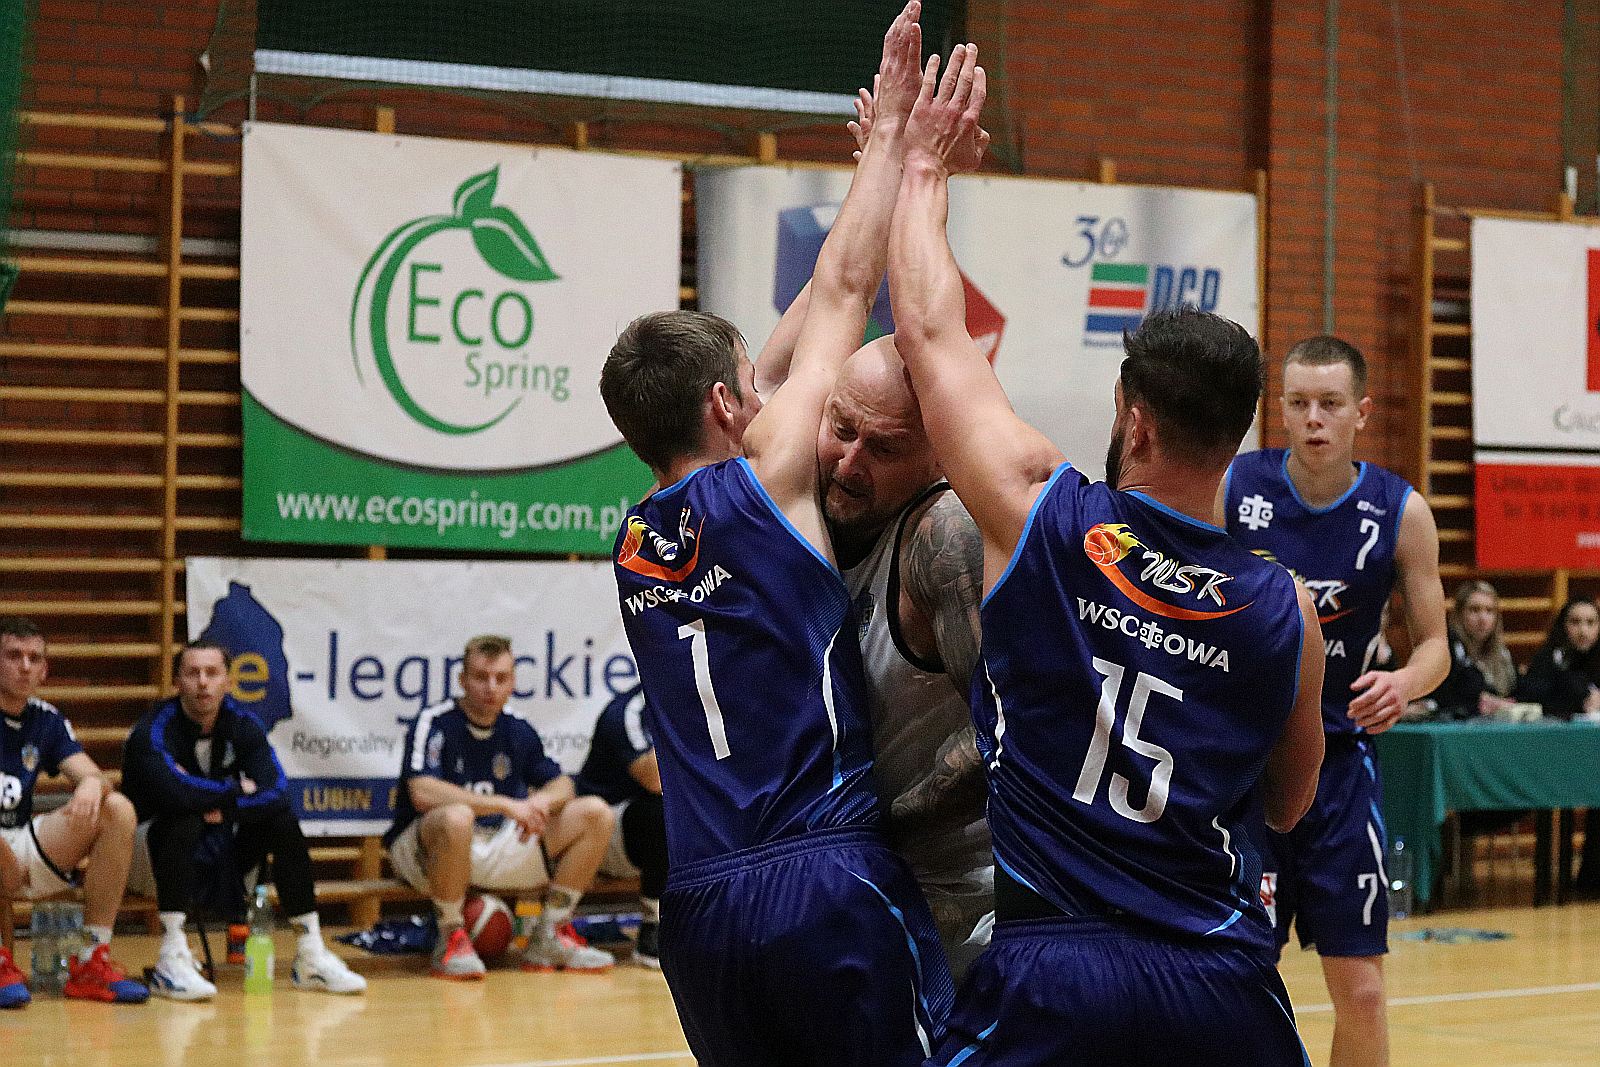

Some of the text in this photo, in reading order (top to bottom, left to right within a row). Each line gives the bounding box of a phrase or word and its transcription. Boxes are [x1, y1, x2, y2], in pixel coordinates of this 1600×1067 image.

[407, 263, 534, 350] Eco
[464, 352, 571, 402] Spring
[275, 489, 630, 540] www.ecospring.com.pl
[1355, 518, 1380, 571] 7
[1140, 550, 1235, 607] WSK
[677, 618, 731, 760] 1
[1072, 656, 1184, 824] 15
[1357, 872, 1378, 926] 7
